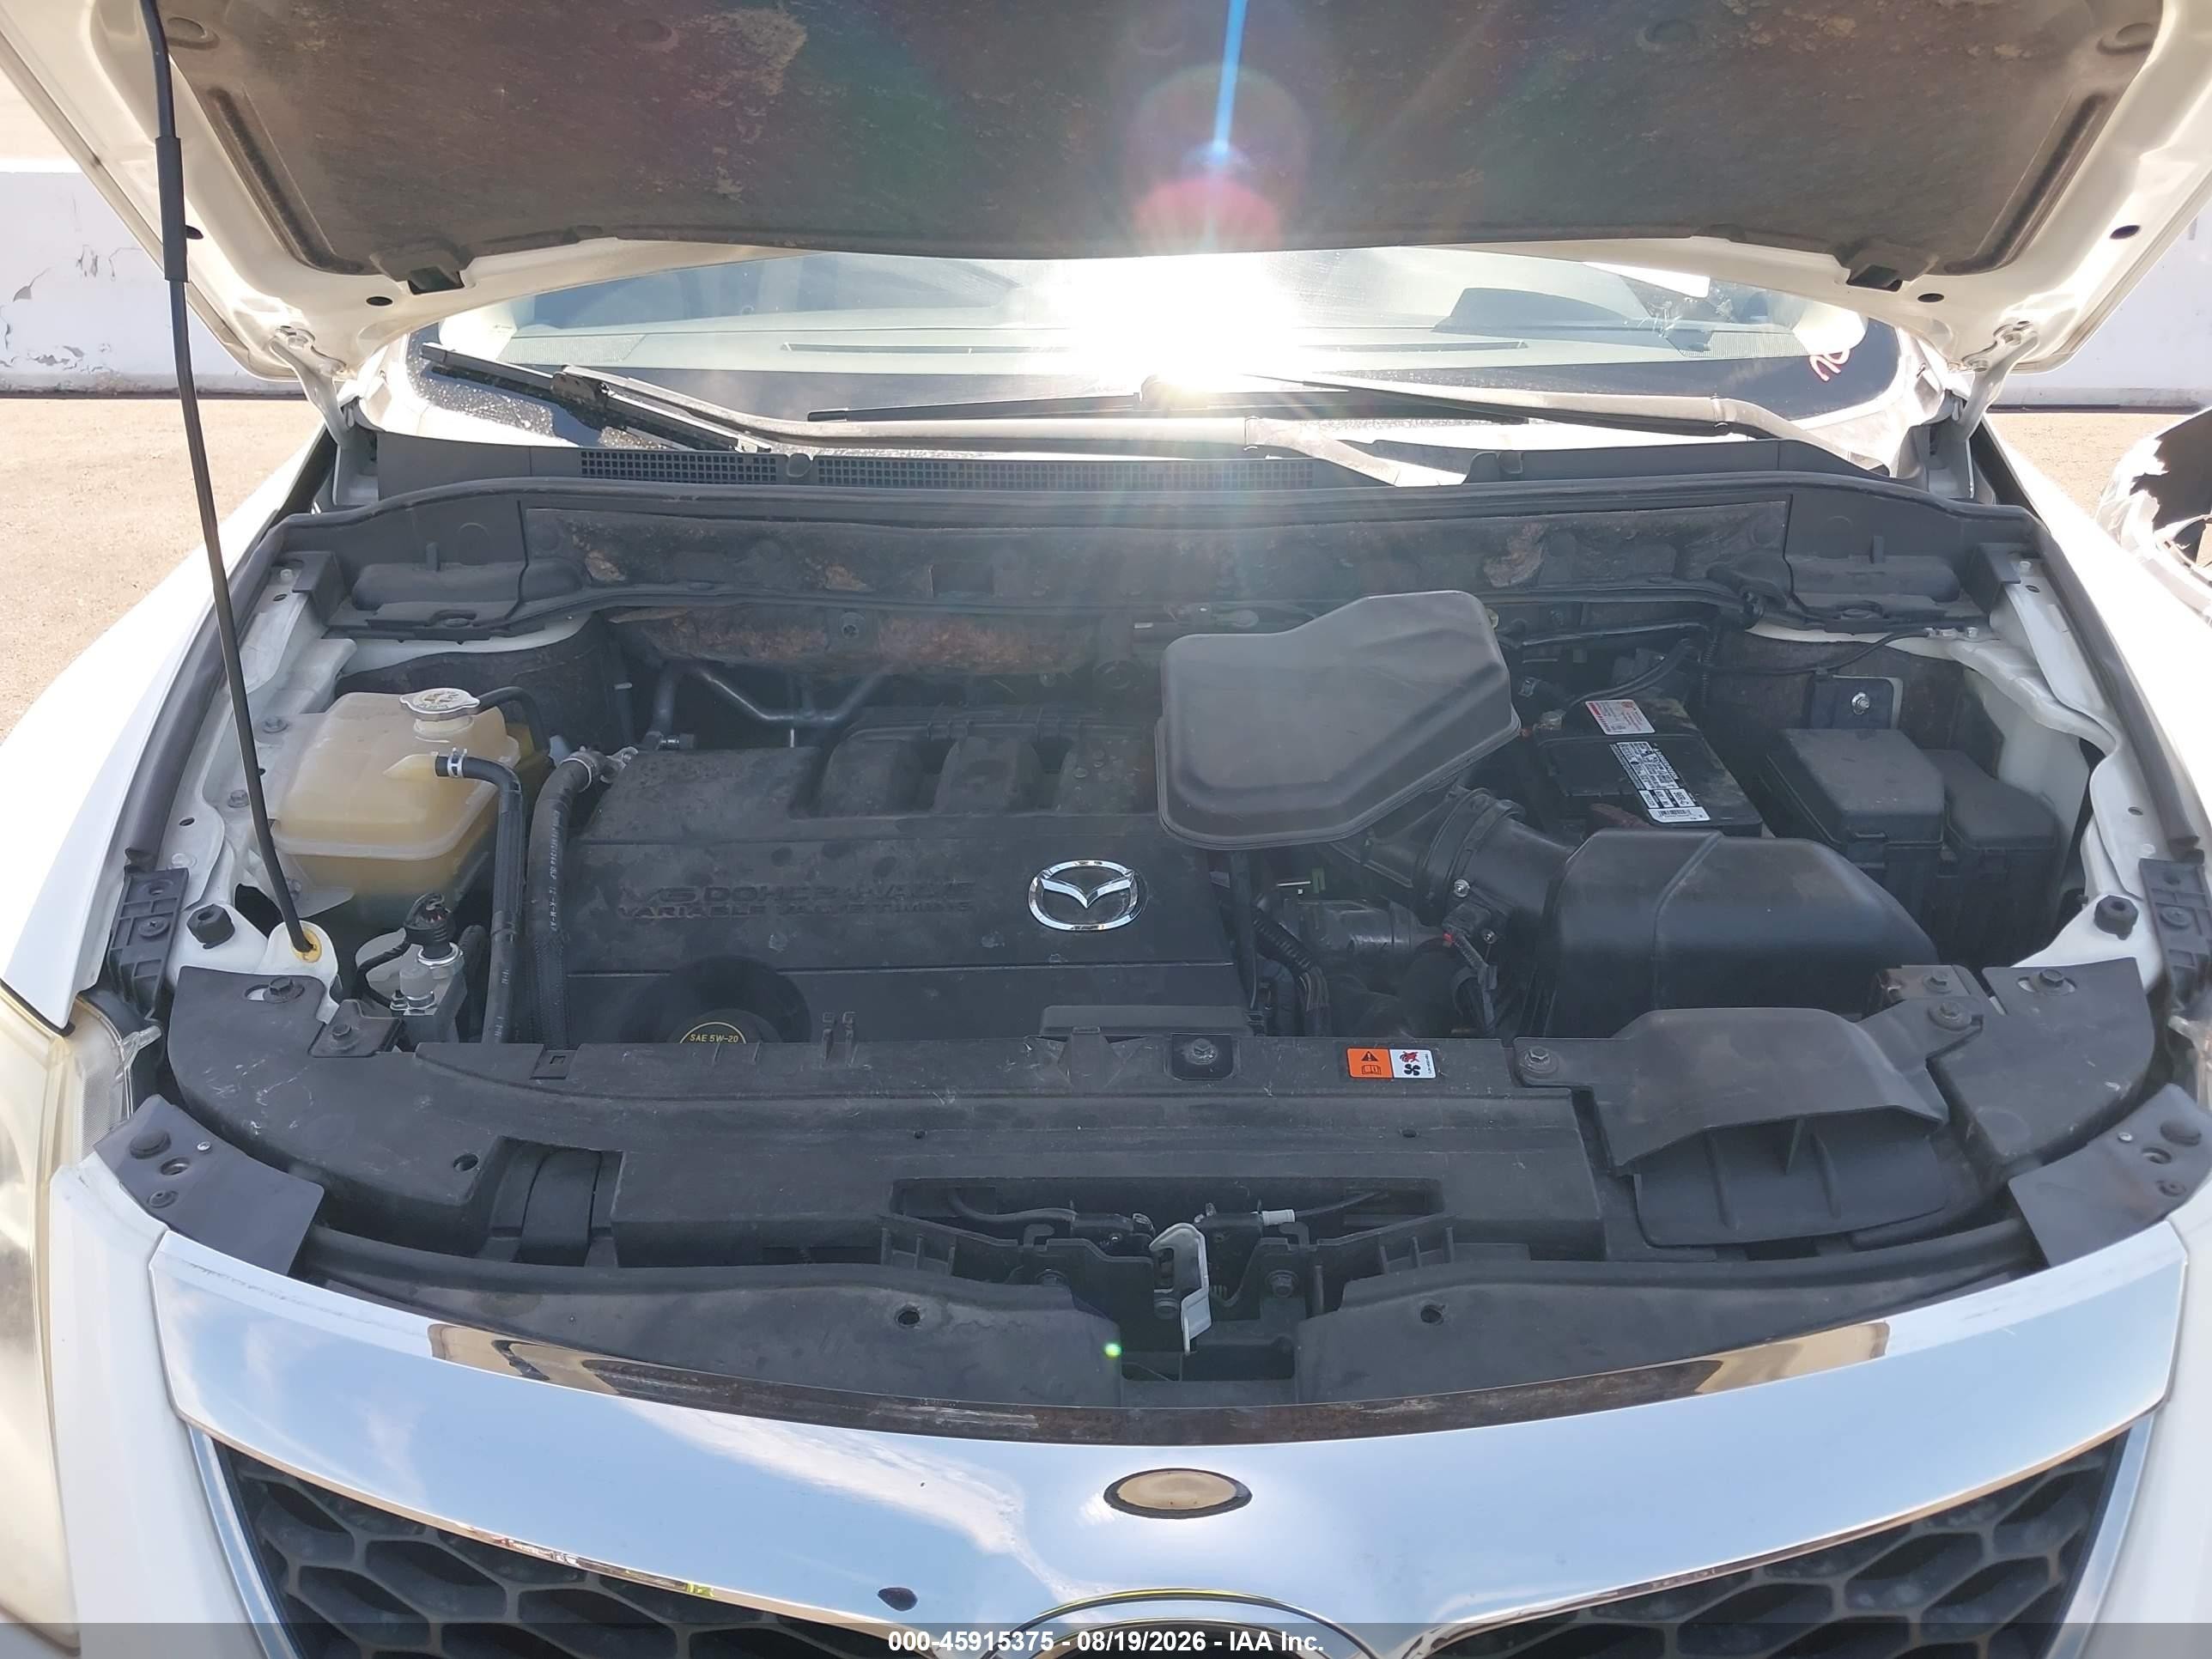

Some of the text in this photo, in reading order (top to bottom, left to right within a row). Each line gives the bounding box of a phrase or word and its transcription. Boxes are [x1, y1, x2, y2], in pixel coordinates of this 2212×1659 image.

[617, 905, 768, 919] VARIABLE
[690, 1034, 739, 1043] SAE 5W-20
